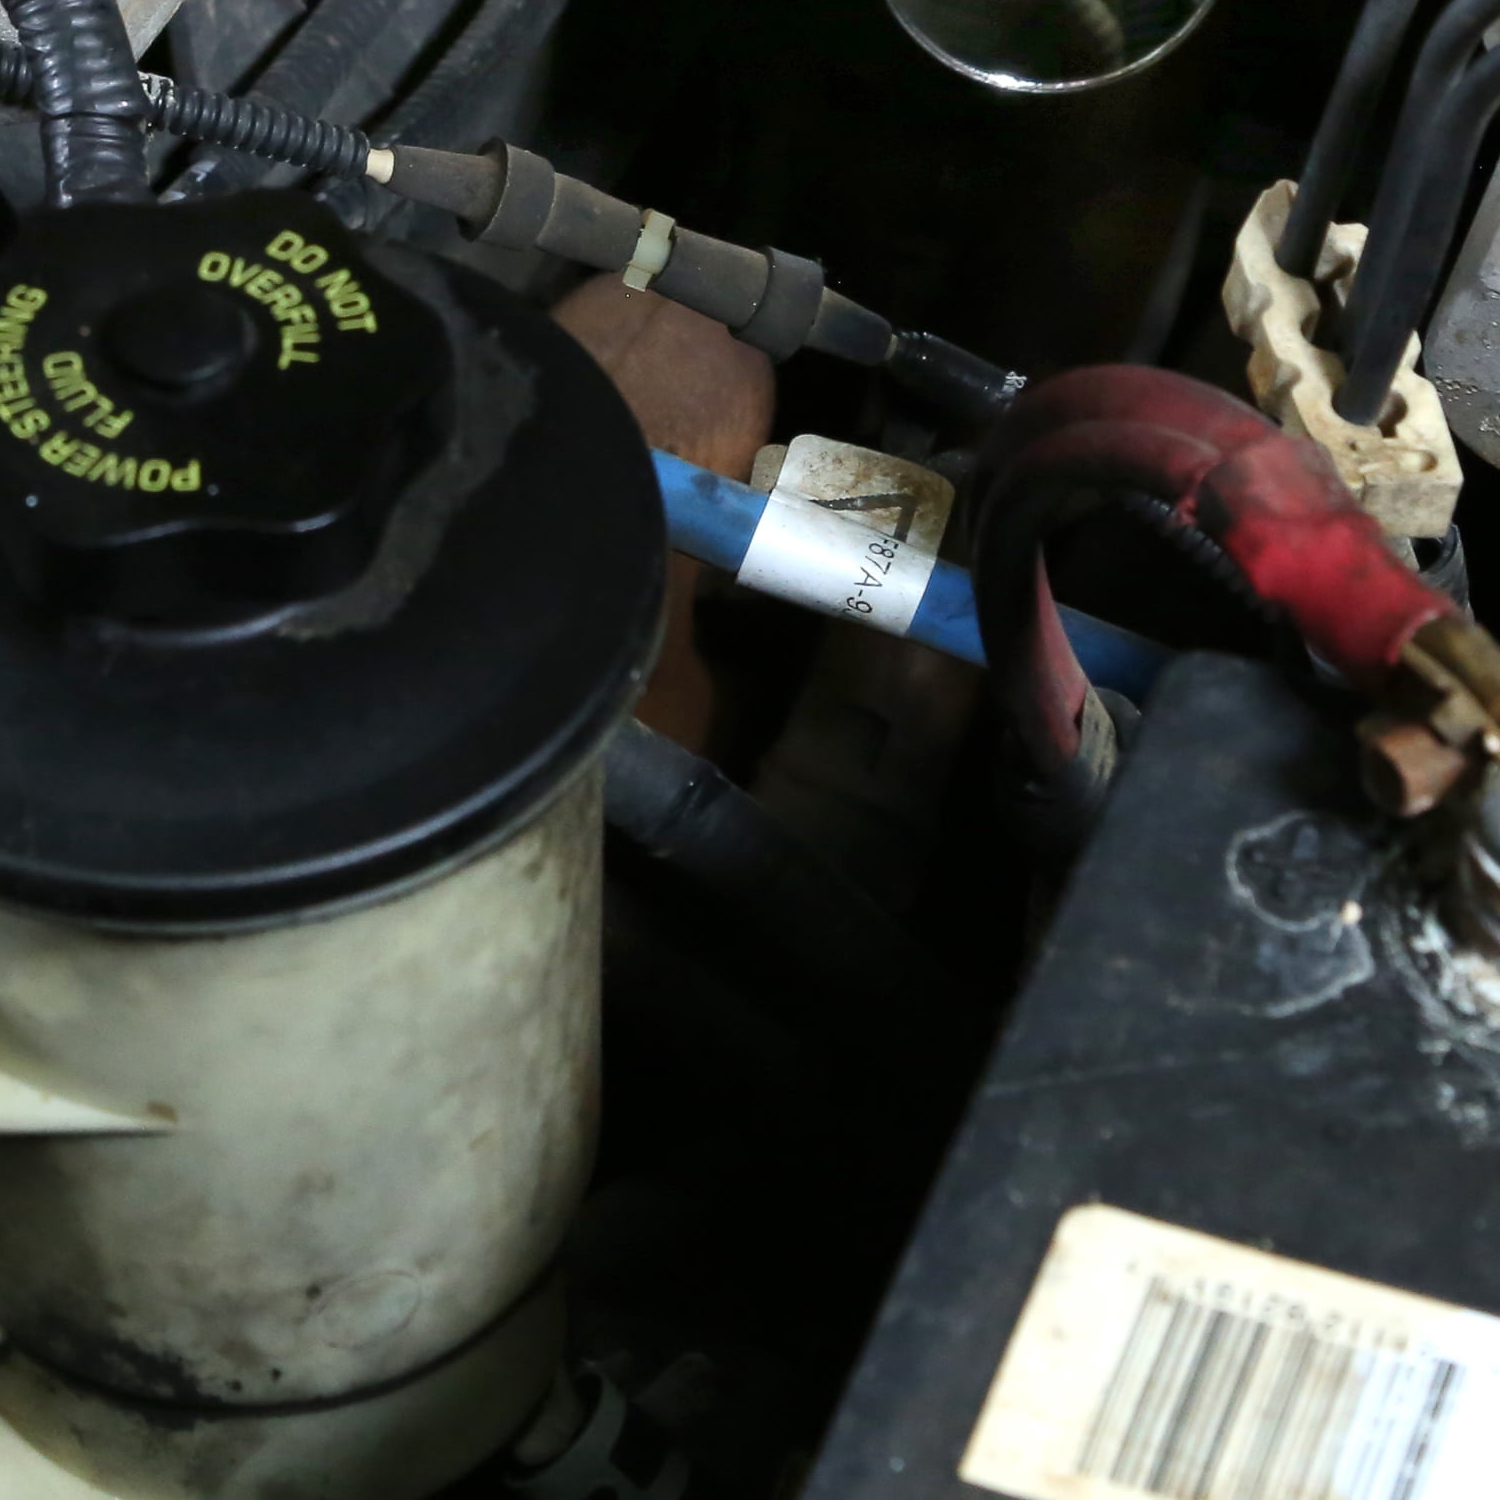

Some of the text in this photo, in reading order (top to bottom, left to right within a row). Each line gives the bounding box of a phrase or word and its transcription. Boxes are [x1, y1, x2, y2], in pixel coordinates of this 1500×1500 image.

[197, 251, 322, 371] OVERFILL
[264, 229, 378, 334] DO NOT
[42, 350, 135, 439] FLUID
[39, 430, 201, 493] POWER
